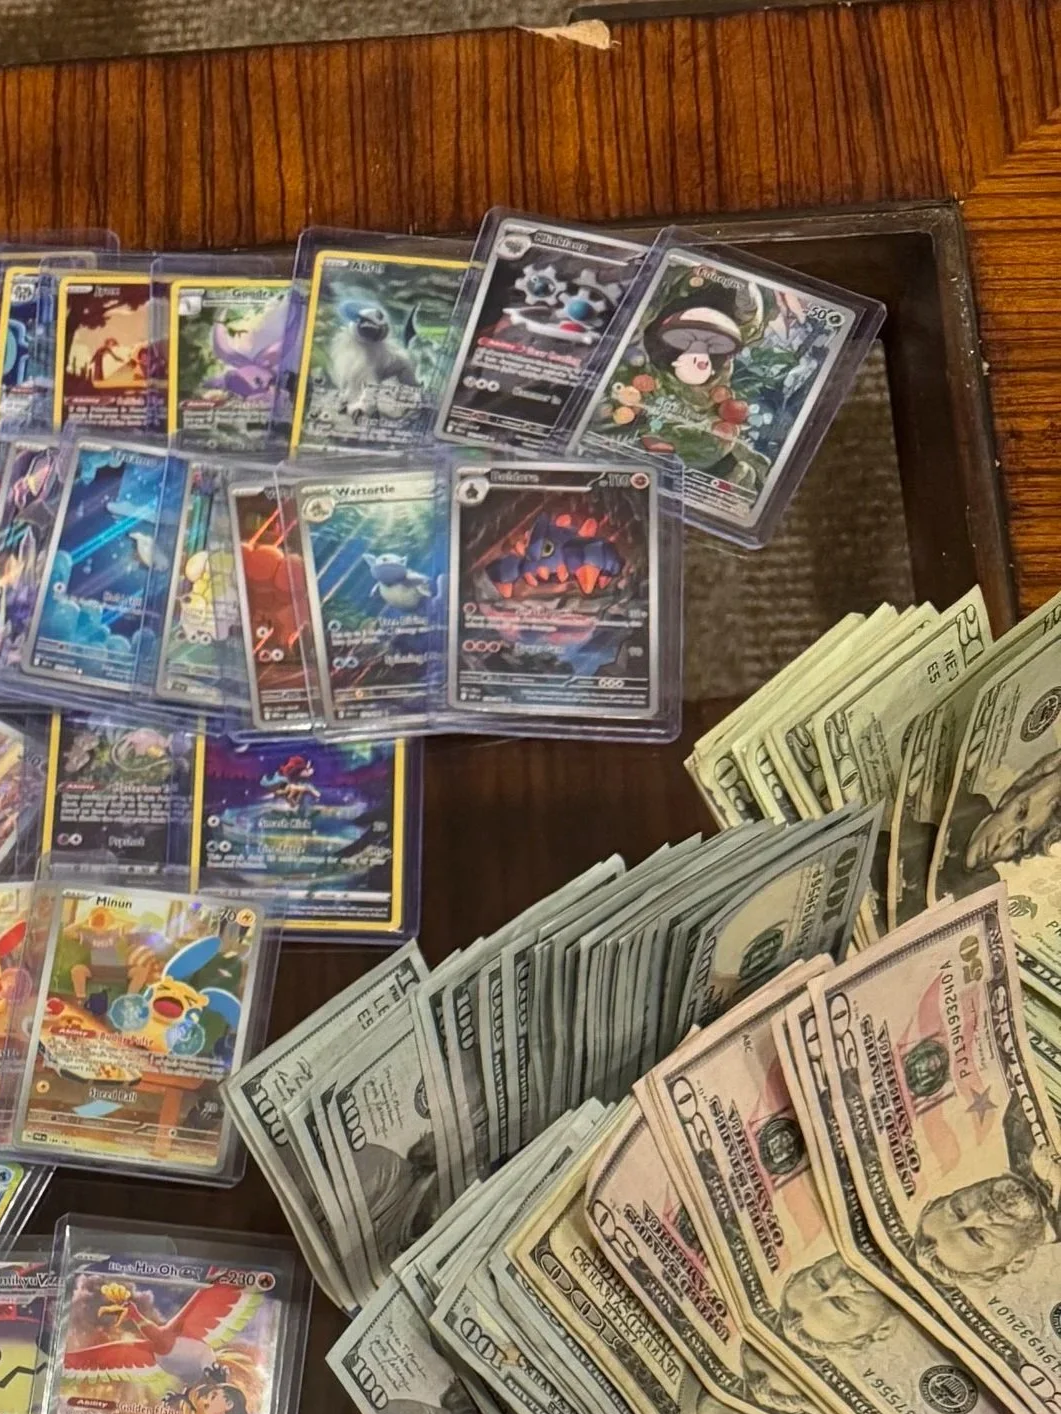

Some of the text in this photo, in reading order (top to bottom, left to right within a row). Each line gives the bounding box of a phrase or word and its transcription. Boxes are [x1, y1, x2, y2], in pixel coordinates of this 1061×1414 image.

[335, 484, 396, 501] Wartortle
[95, 894, 133, 910] Minun
[958, 934, 984, 985] 50
[828, 991, 860, 1070] 50
[253, 1088, 290, 1148] 100
[341, 1089, 368, 1153] 100
[669, 1075, 715, 1153] 50
[591, 1199, 641, 1260] 50
[228, 1270, 256, 1287] 230
[460, 1317, 506, 1373] 100
[75, 1398, 109, 1409] Ability
[353, 1352, 390, 1411] 100
